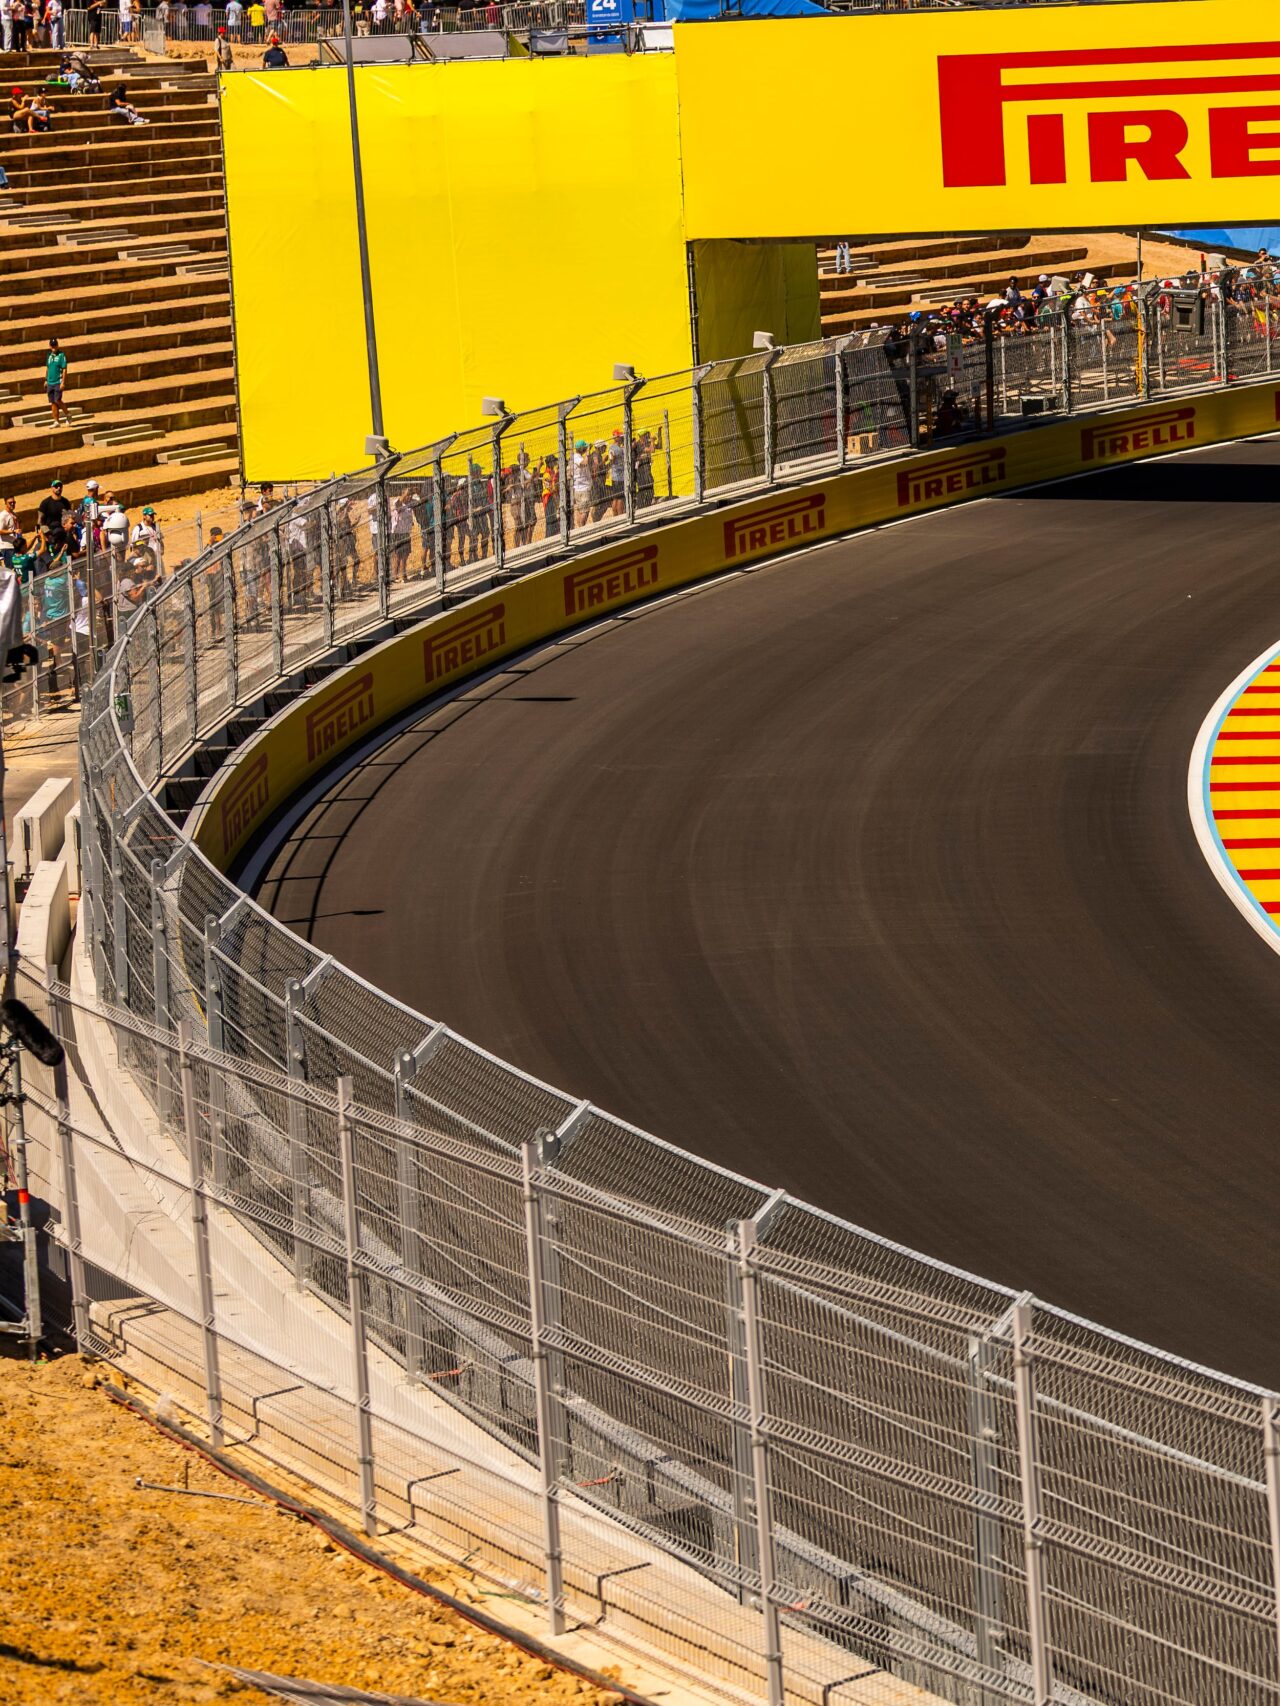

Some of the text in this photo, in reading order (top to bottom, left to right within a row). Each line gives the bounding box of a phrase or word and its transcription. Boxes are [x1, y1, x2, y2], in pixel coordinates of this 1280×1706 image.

[592, 0, 617, 11] 24
[1080, 406, 1196, 461] PIRELLI
[896, 446, 1007, 507] PIRELLI
[723, 492, 826, 559] PIRELLI
[563, 543, 659, 617] PIRELLI
[423, 602, 506, 683] PIRELLI
[305, 672, 375, 764] PIRELLI
[221, 752, 269, 856] PIRELLI
